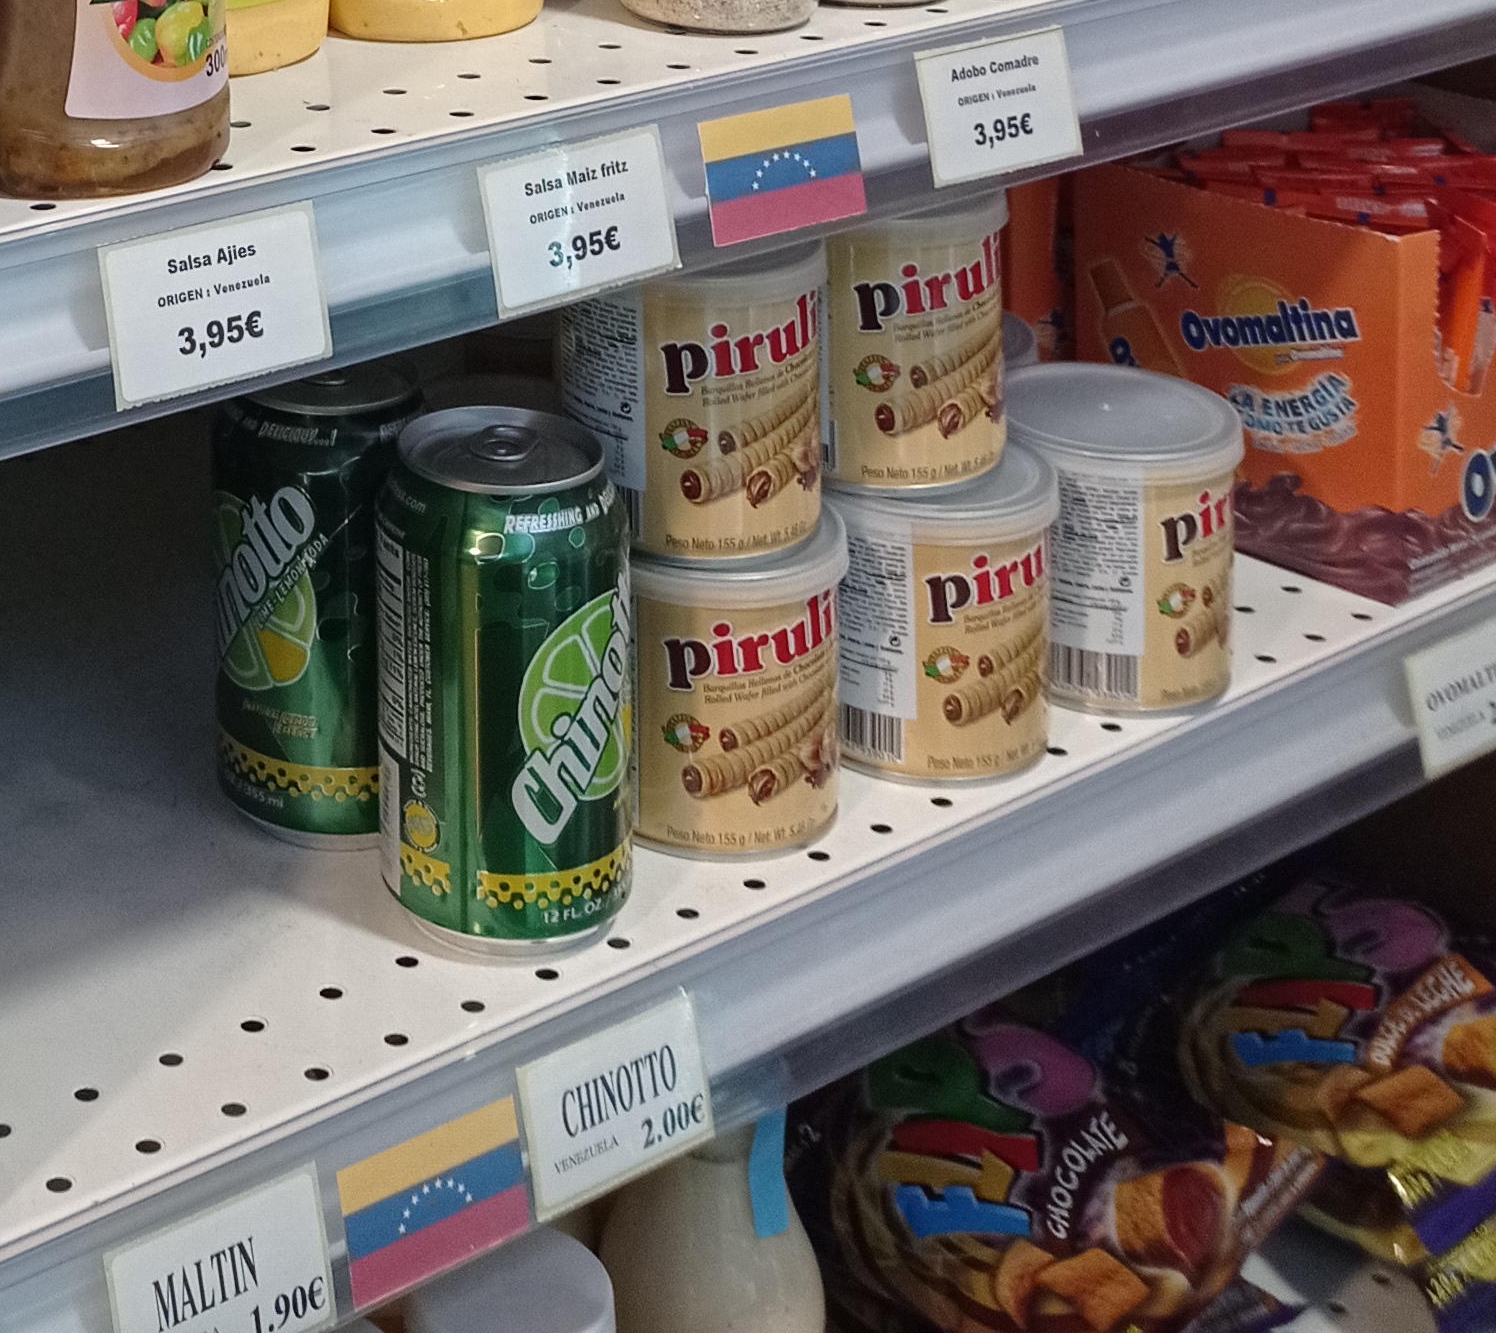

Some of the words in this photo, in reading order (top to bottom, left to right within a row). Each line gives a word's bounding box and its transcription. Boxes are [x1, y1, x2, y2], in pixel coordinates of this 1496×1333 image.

[951, 65, 986, 82] Adobo
[990, 54, 1039, 74] Comadre
[973, 113, 1034, 148] 3,95€
[524, 175, 564, 198] Salsa
[566, 167, 599, 187] Maiz
[601, 159, 628, 180] fritz
[167, 253, 212, 274] Salsa
[217, 244, 256, 265] Ajies
[548, 225, 621, 269] 3,95€
[158, 288, 203, 307] ORIGEN
[214, 274, 270, 295] Venezuela
[178, 310, 263, 358] 3,95€
[1181, 297, 1361, 351] Ovomaltina
[560, 1044, 676, 1138] CHINOTTO
[553, 1136, 619, 1175] VENEZUELA
[641, 1094, 704, 1149] 2.00€
[1045, 1111, 1129, 1240] CHOCOLATE
[153, 1236, 258, 1333] MALTIN
